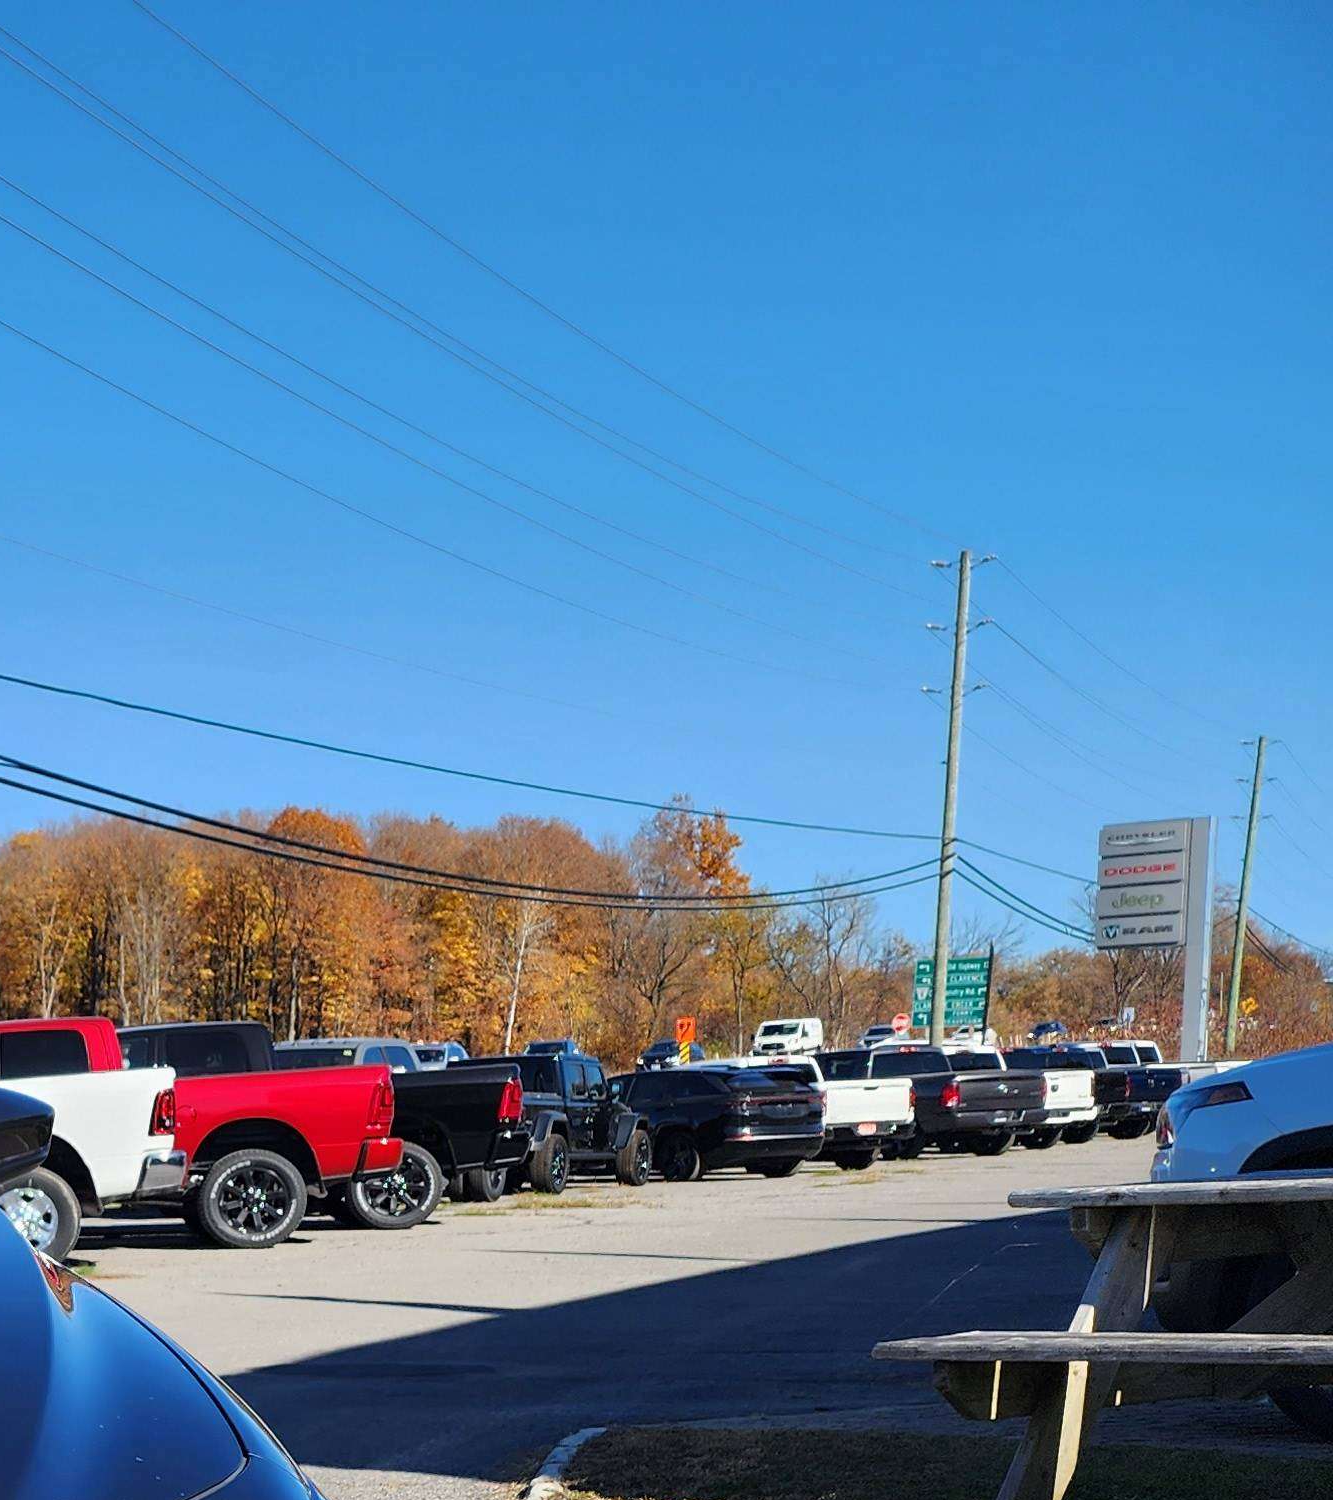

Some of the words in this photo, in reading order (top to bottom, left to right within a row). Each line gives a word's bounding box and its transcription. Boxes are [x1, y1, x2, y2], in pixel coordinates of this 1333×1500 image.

[1104, 863, 1178, 876] DODGE
[1111, 893, 1164, 909] Jeep
[1122, 924, 1173, 935] RAM
